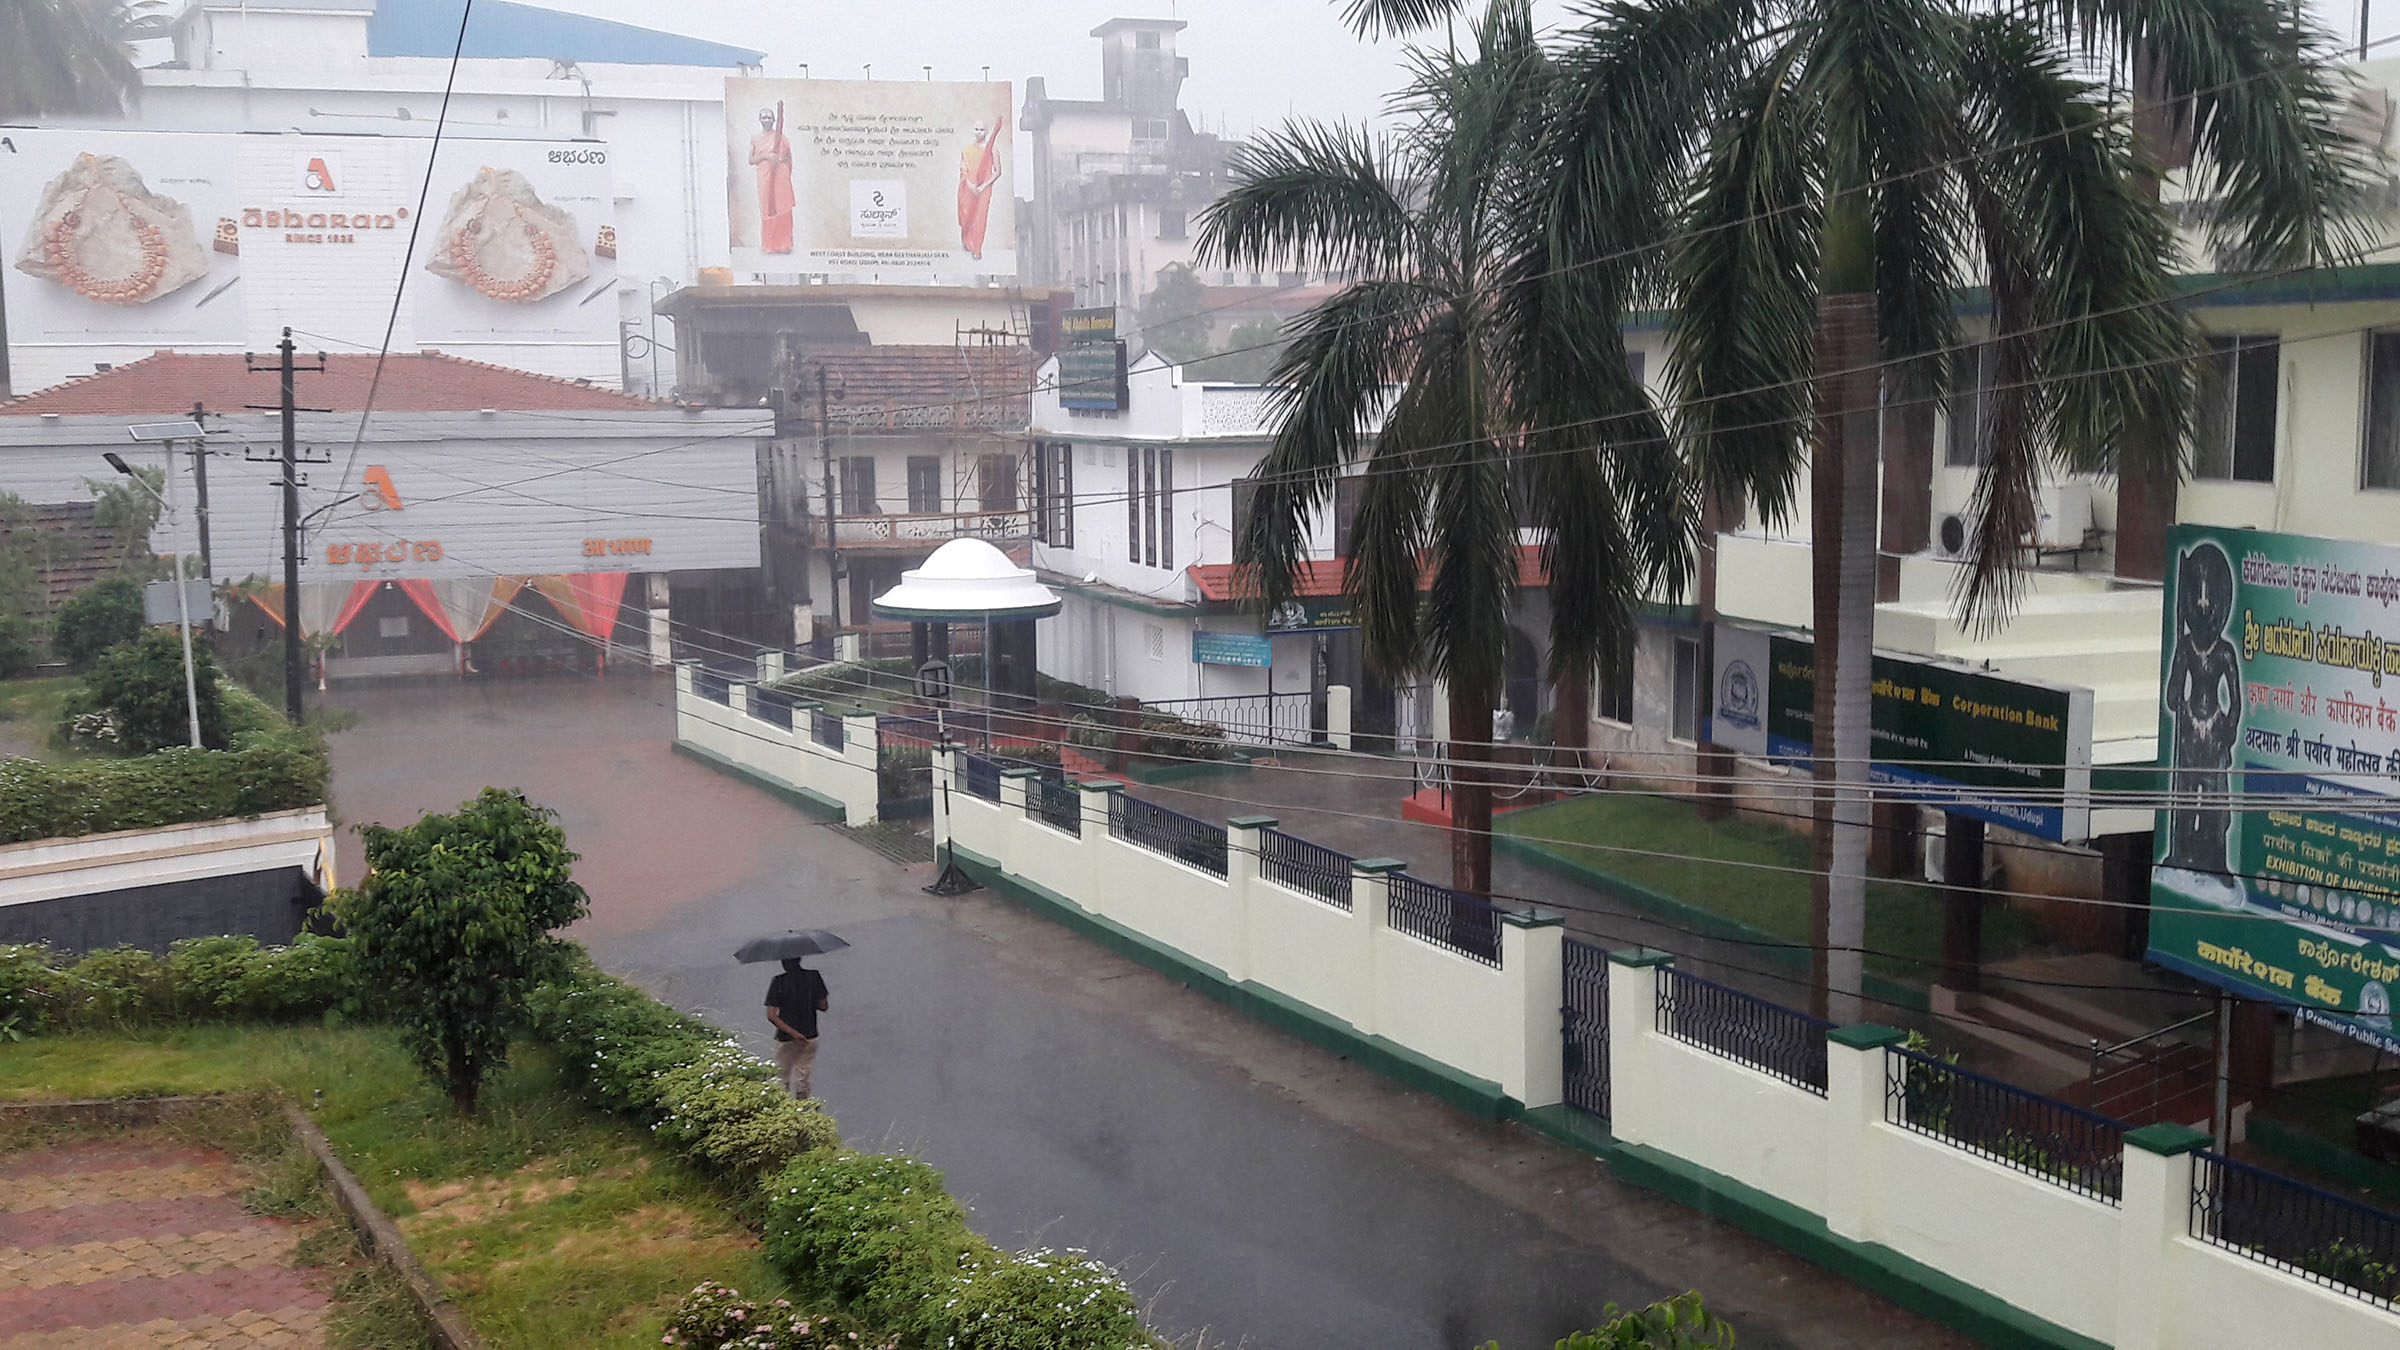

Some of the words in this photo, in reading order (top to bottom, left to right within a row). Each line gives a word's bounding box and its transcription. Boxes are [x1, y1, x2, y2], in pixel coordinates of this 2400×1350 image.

[547, 149, 607, 167] ಆಭರಣ
[2244, 608, 2260, 662] ಶ್ರೀ
[1952, 695, 2023, 724] Corporation
[2025, 709, 2060, 732] Bank
[2300, 685, 2318, 716] और
[2376, 696, 2398, 732] बैंक
[2286, 728, 2301, 760] श्री
[2265, 854, 2324, 884] EXHIBITION
[2325, 873, 2340, 887] OF
[2342, 877, 2390, 902] ANCIENT
[2296, 1007, 2304, 1018] A
[2306, 1010, 2347, 1035] Premier
[2348, 1025, 2382, 1048] Public
